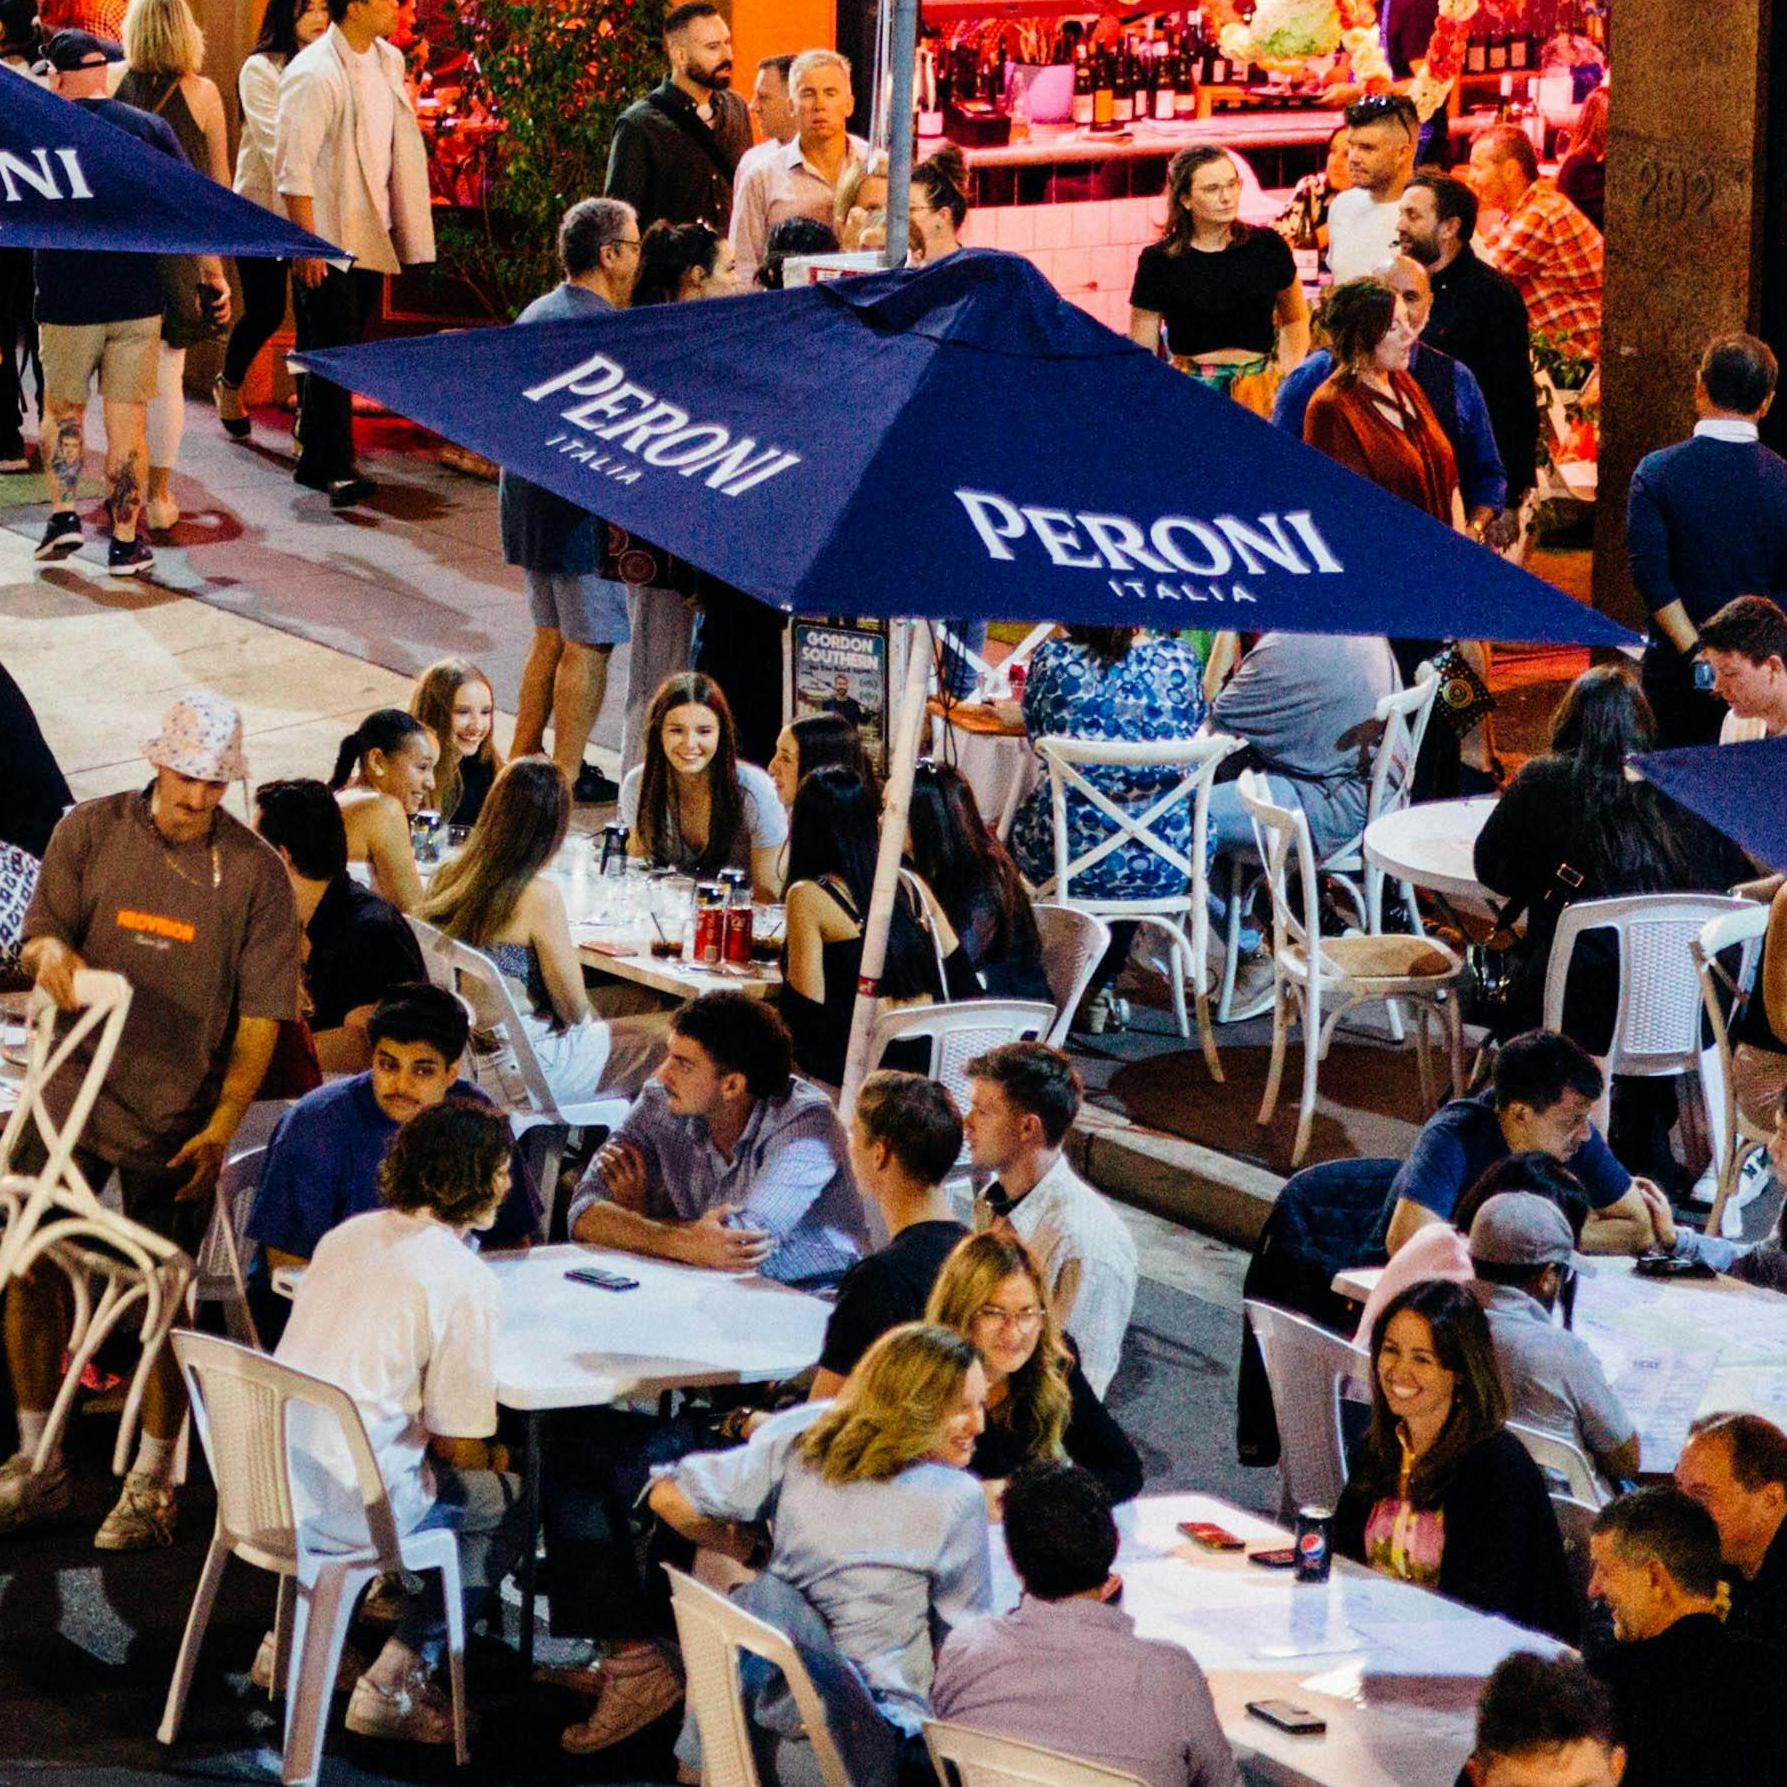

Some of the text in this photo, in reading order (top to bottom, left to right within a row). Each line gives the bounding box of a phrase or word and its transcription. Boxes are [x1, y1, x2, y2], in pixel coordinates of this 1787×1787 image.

[521, 354, 803, 497] PERONI
[544, 435, 643, 486] ITALIA
[953, 488, 1345, 576] PERONI
[1107, 578, 1257, 603] ITALIA
[802, 646, 880, 670] SOUTHERN
[806, 631, 875, 654] GORDON
